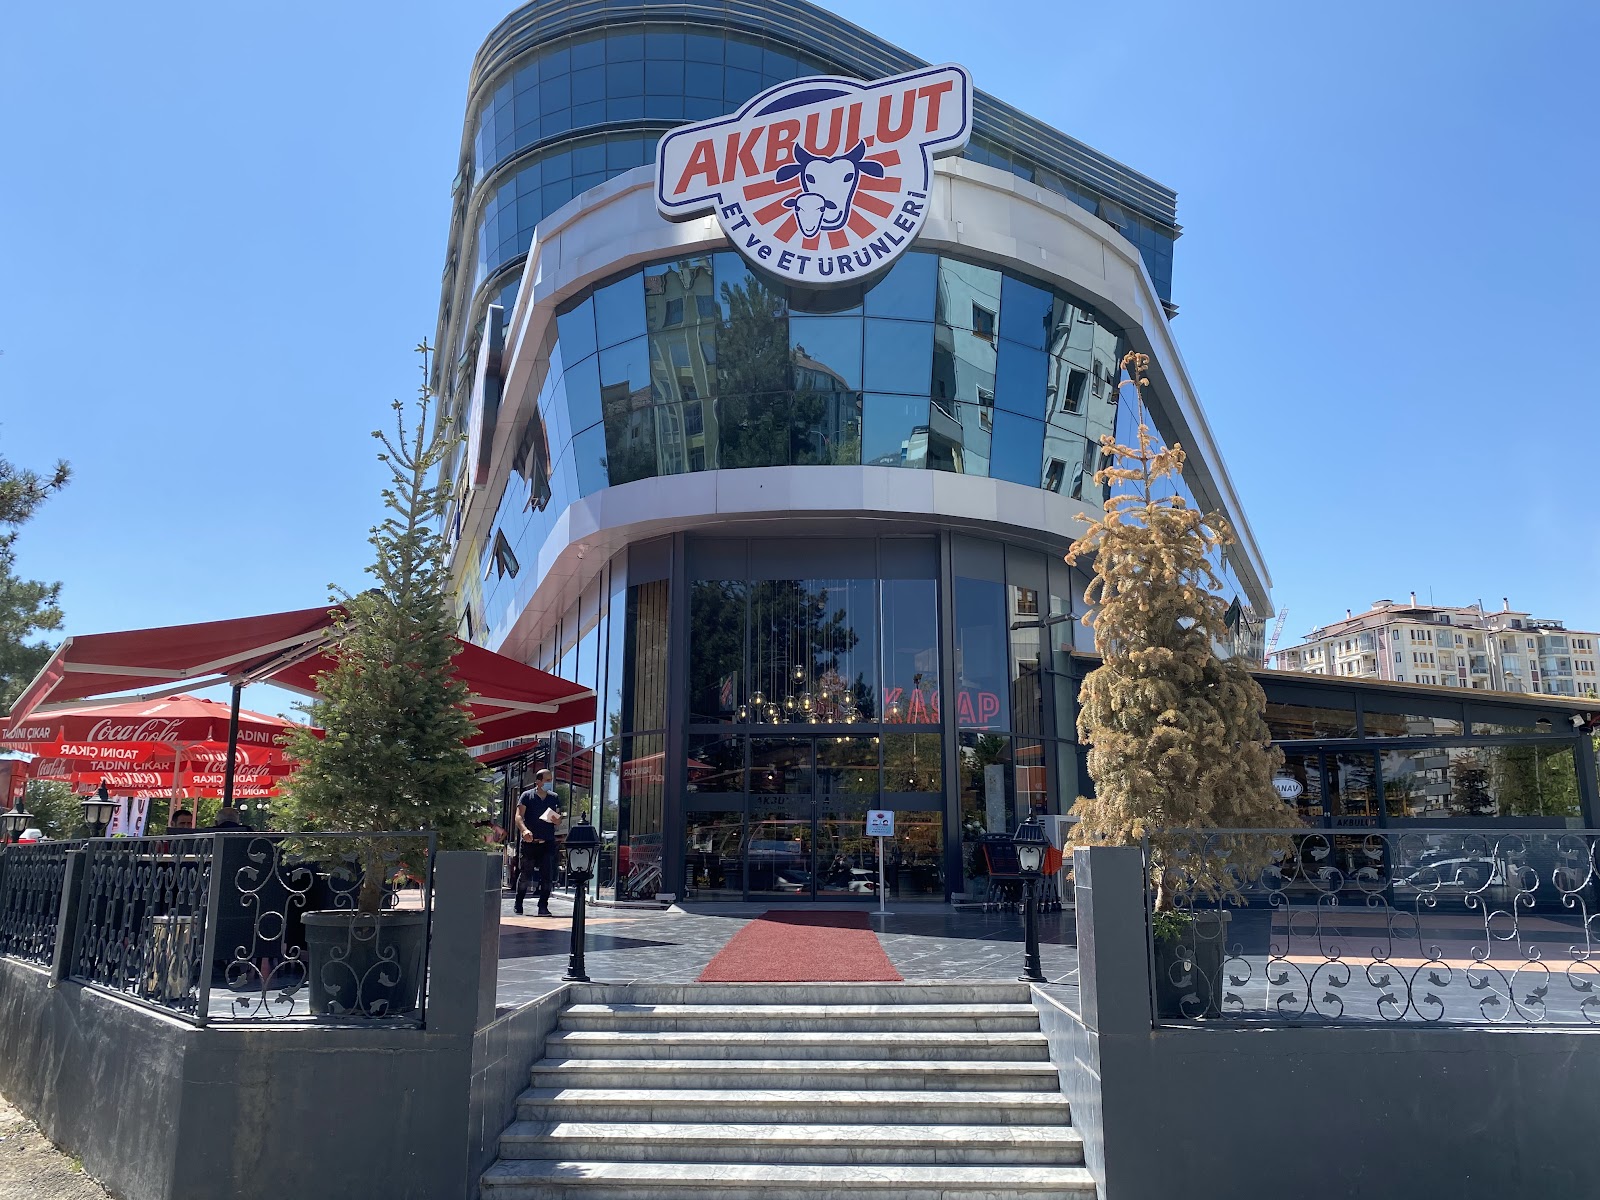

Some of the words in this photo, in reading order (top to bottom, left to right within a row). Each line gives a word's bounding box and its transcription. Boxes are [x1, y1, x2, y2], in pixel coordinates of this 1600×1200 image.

[673, 80, 953, 195] AKBULUT
[721, 201, 751, 232] ET
[746, 234, 772, 260] ve
[777, 251, 811, 275] ET
[818, 190, 927, 276] ÜRÜNLERİ
[237, 730, 269, 743] ADINI
[90, 761, 130, 770] TADINI
